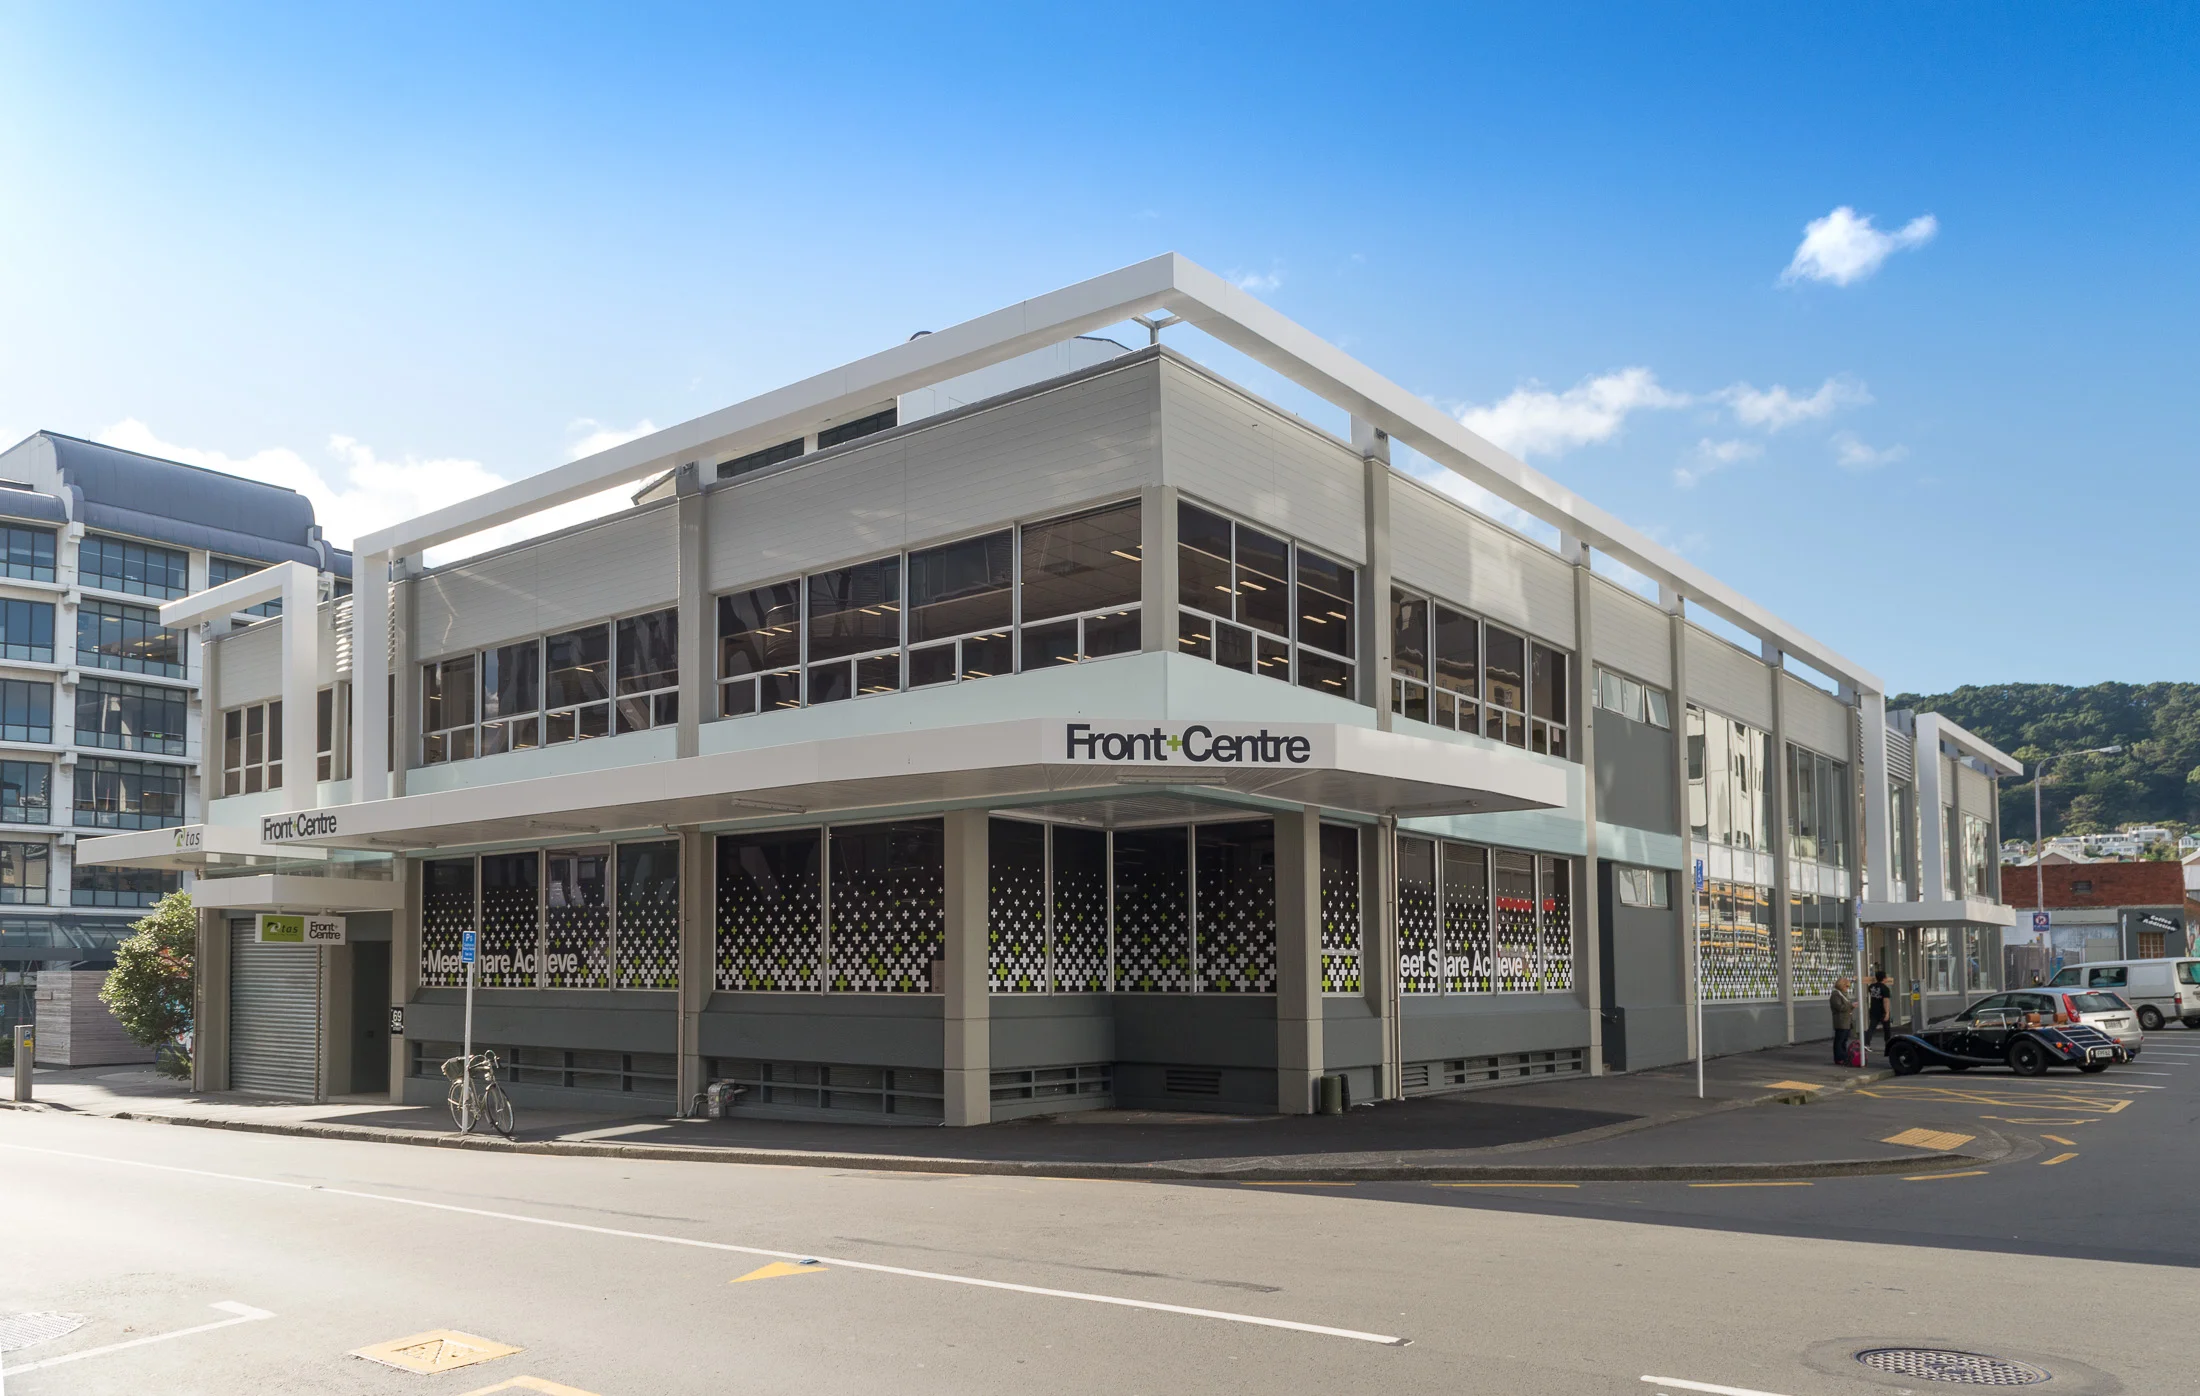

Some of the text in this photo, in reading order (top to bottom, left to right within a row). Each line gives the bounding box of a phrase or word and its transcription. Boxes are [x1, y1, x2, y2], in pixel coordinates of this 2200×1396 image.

[185, 831, 200, 847] tas
[281, 925, 299, 933] tas
[309, 930, 341, 940] Centre
[393, 1011, 402, 1022] 69
